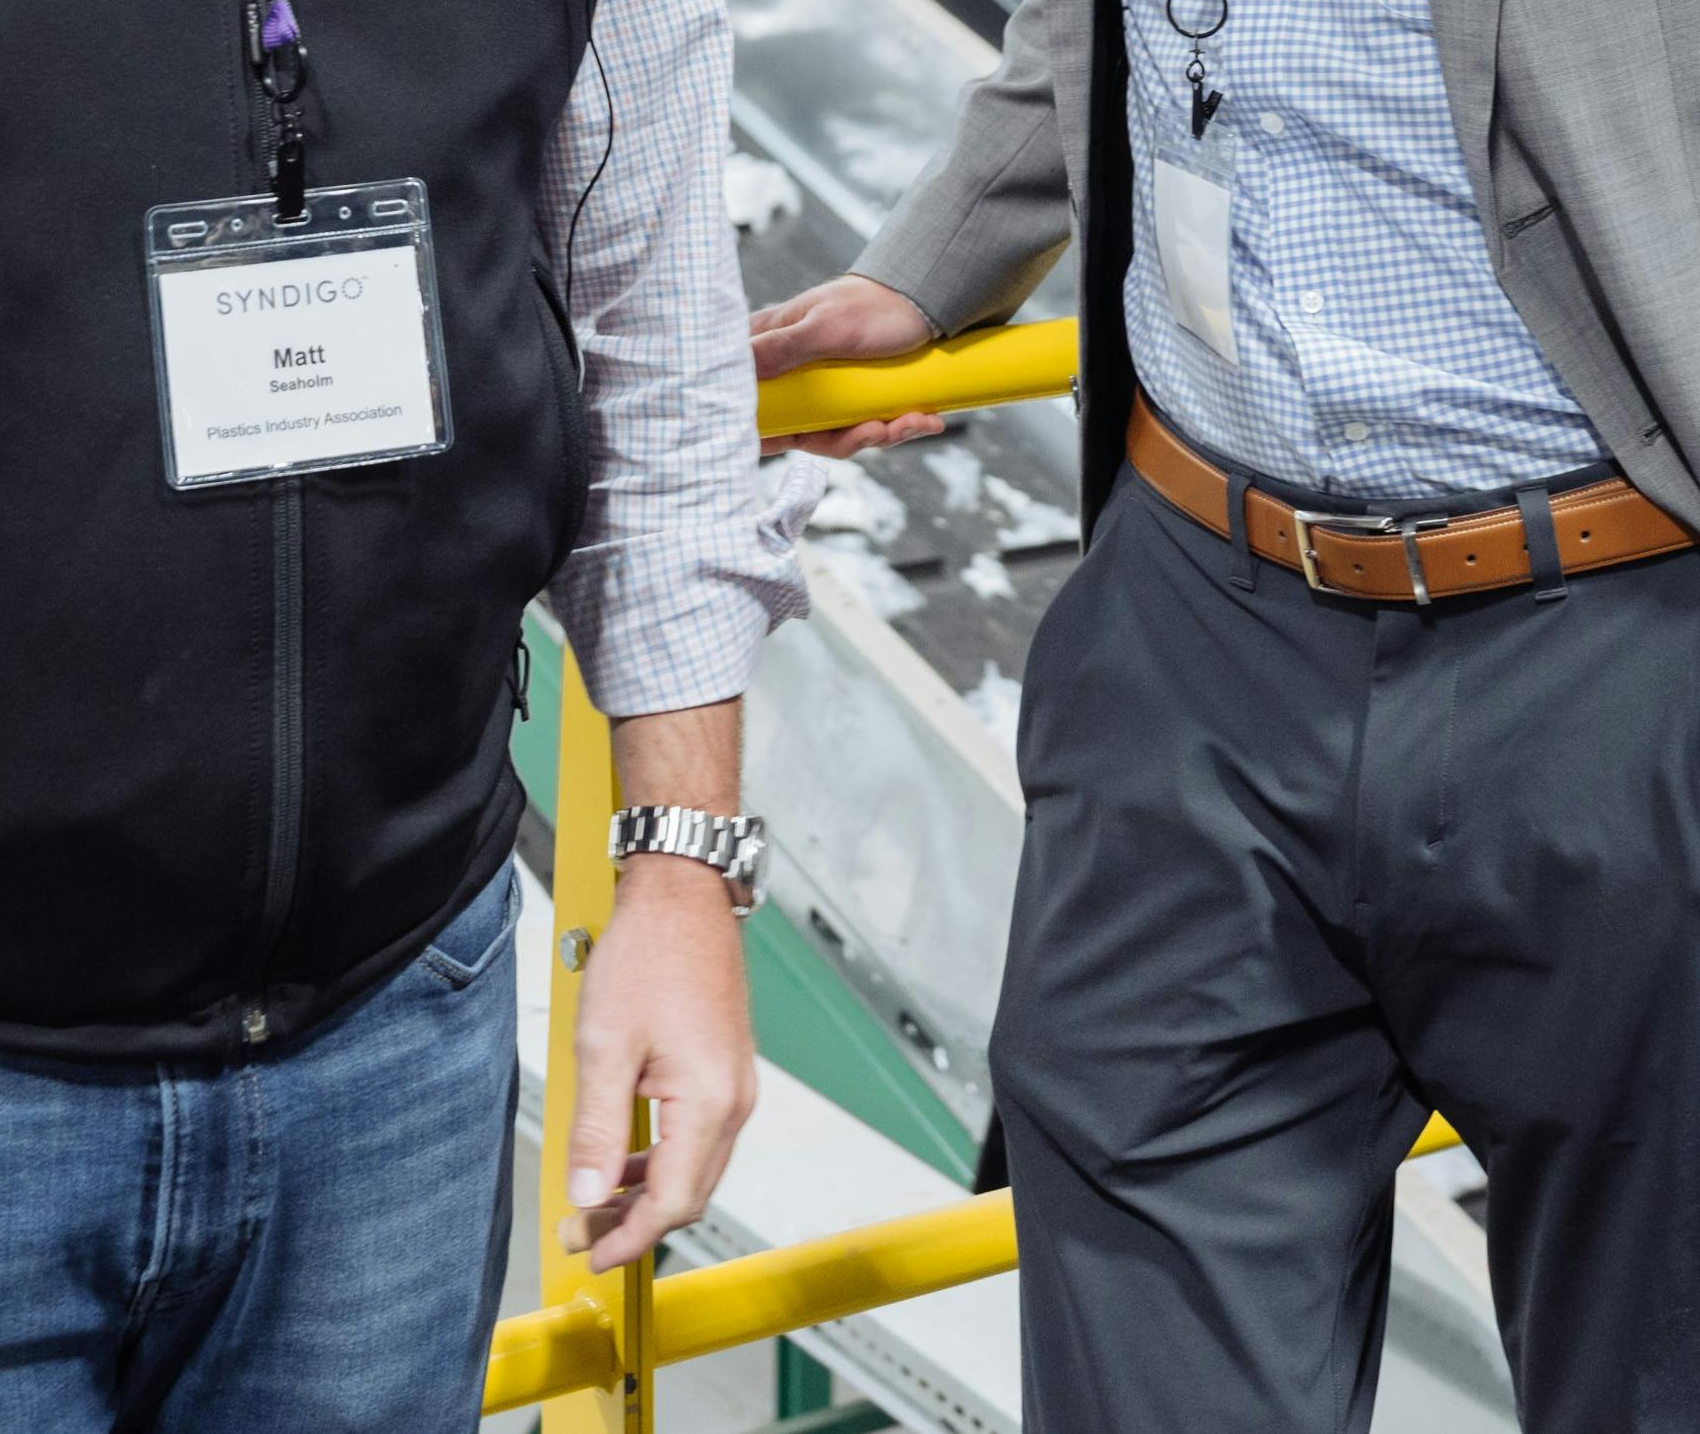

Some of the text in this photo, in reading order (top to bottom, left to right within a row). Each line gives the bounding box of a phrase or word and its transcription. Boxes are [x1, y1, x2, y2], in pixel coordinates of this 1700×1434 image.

[217, 277, 363, 315] SYNDIGO
[274, 345, 325, 369] Matt
[269, 374, 333, 393] Seaholm
[207, 404, 403, 440] Plastics Industry Association
